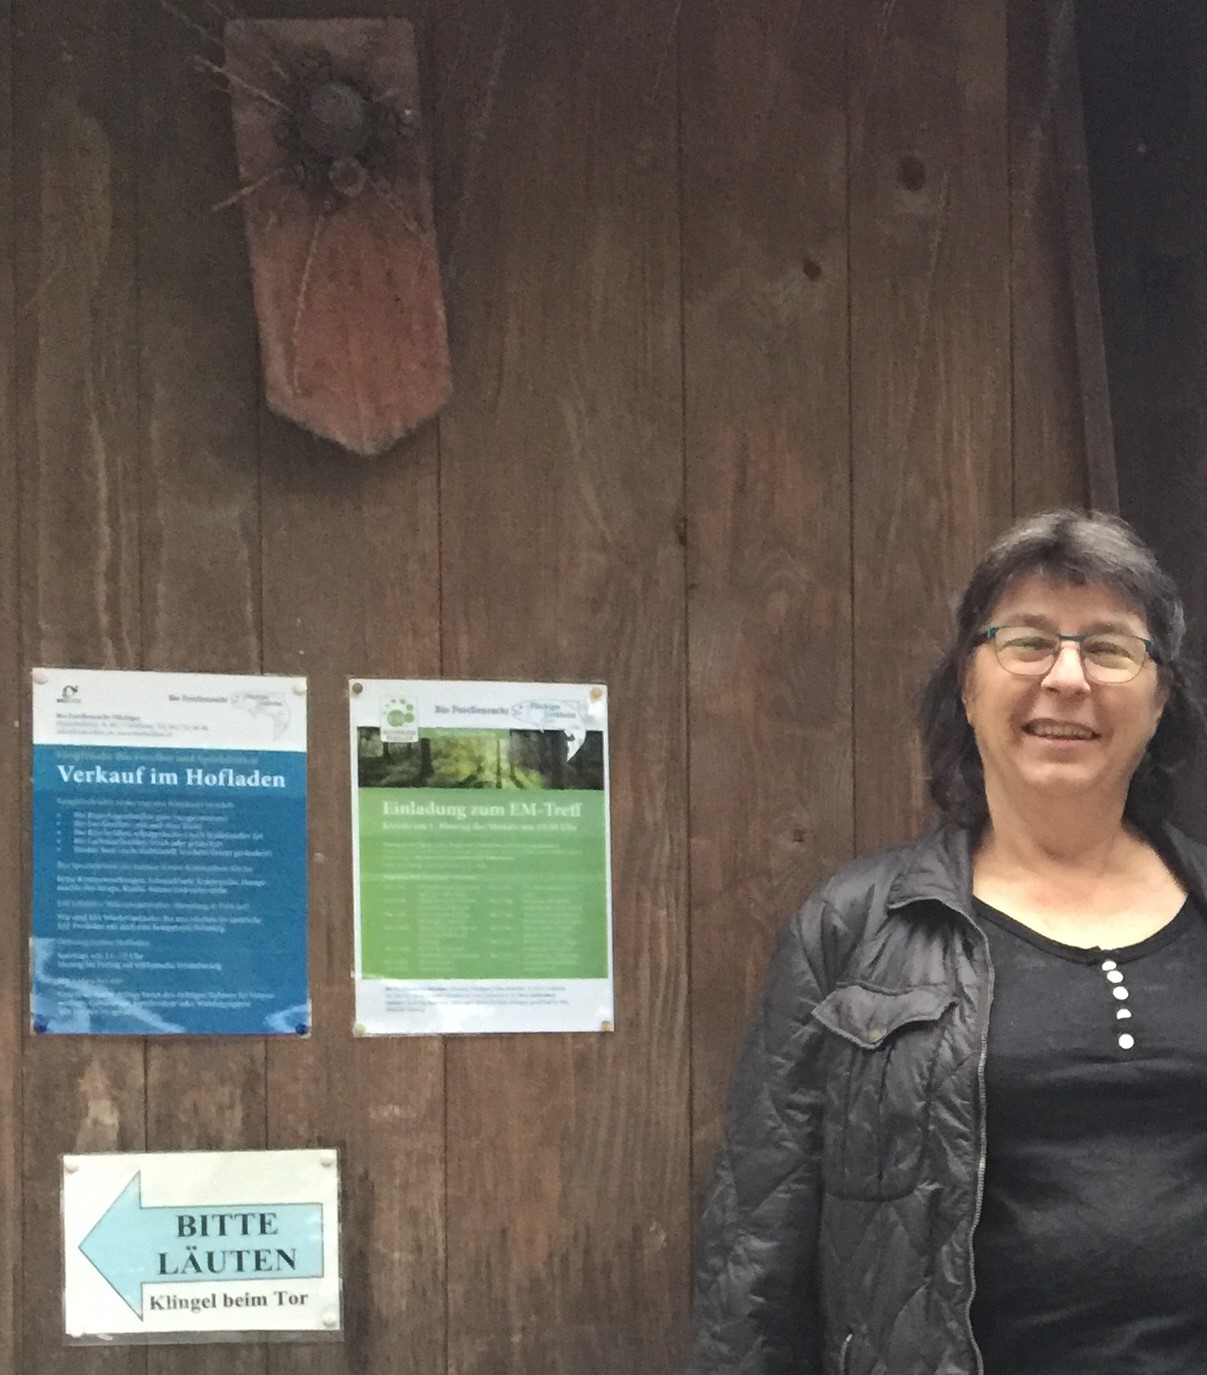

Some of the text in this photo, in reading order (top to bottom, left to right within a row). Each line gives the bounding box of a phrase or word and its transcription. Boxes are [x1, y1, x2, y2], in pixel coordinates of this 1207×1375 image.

[435, 705, 450, 714] Bio
[57, 764, 286, 789] Verkauf im Hofladen
[383, 801, 584, 820] Einladung zum EM-Treff
[176, 1211, 279, 1238] BITTE
[157, 1245, 298, 1276] LÄUTEN
[150, 1290, 309, 1314] Klingel beim Tor
